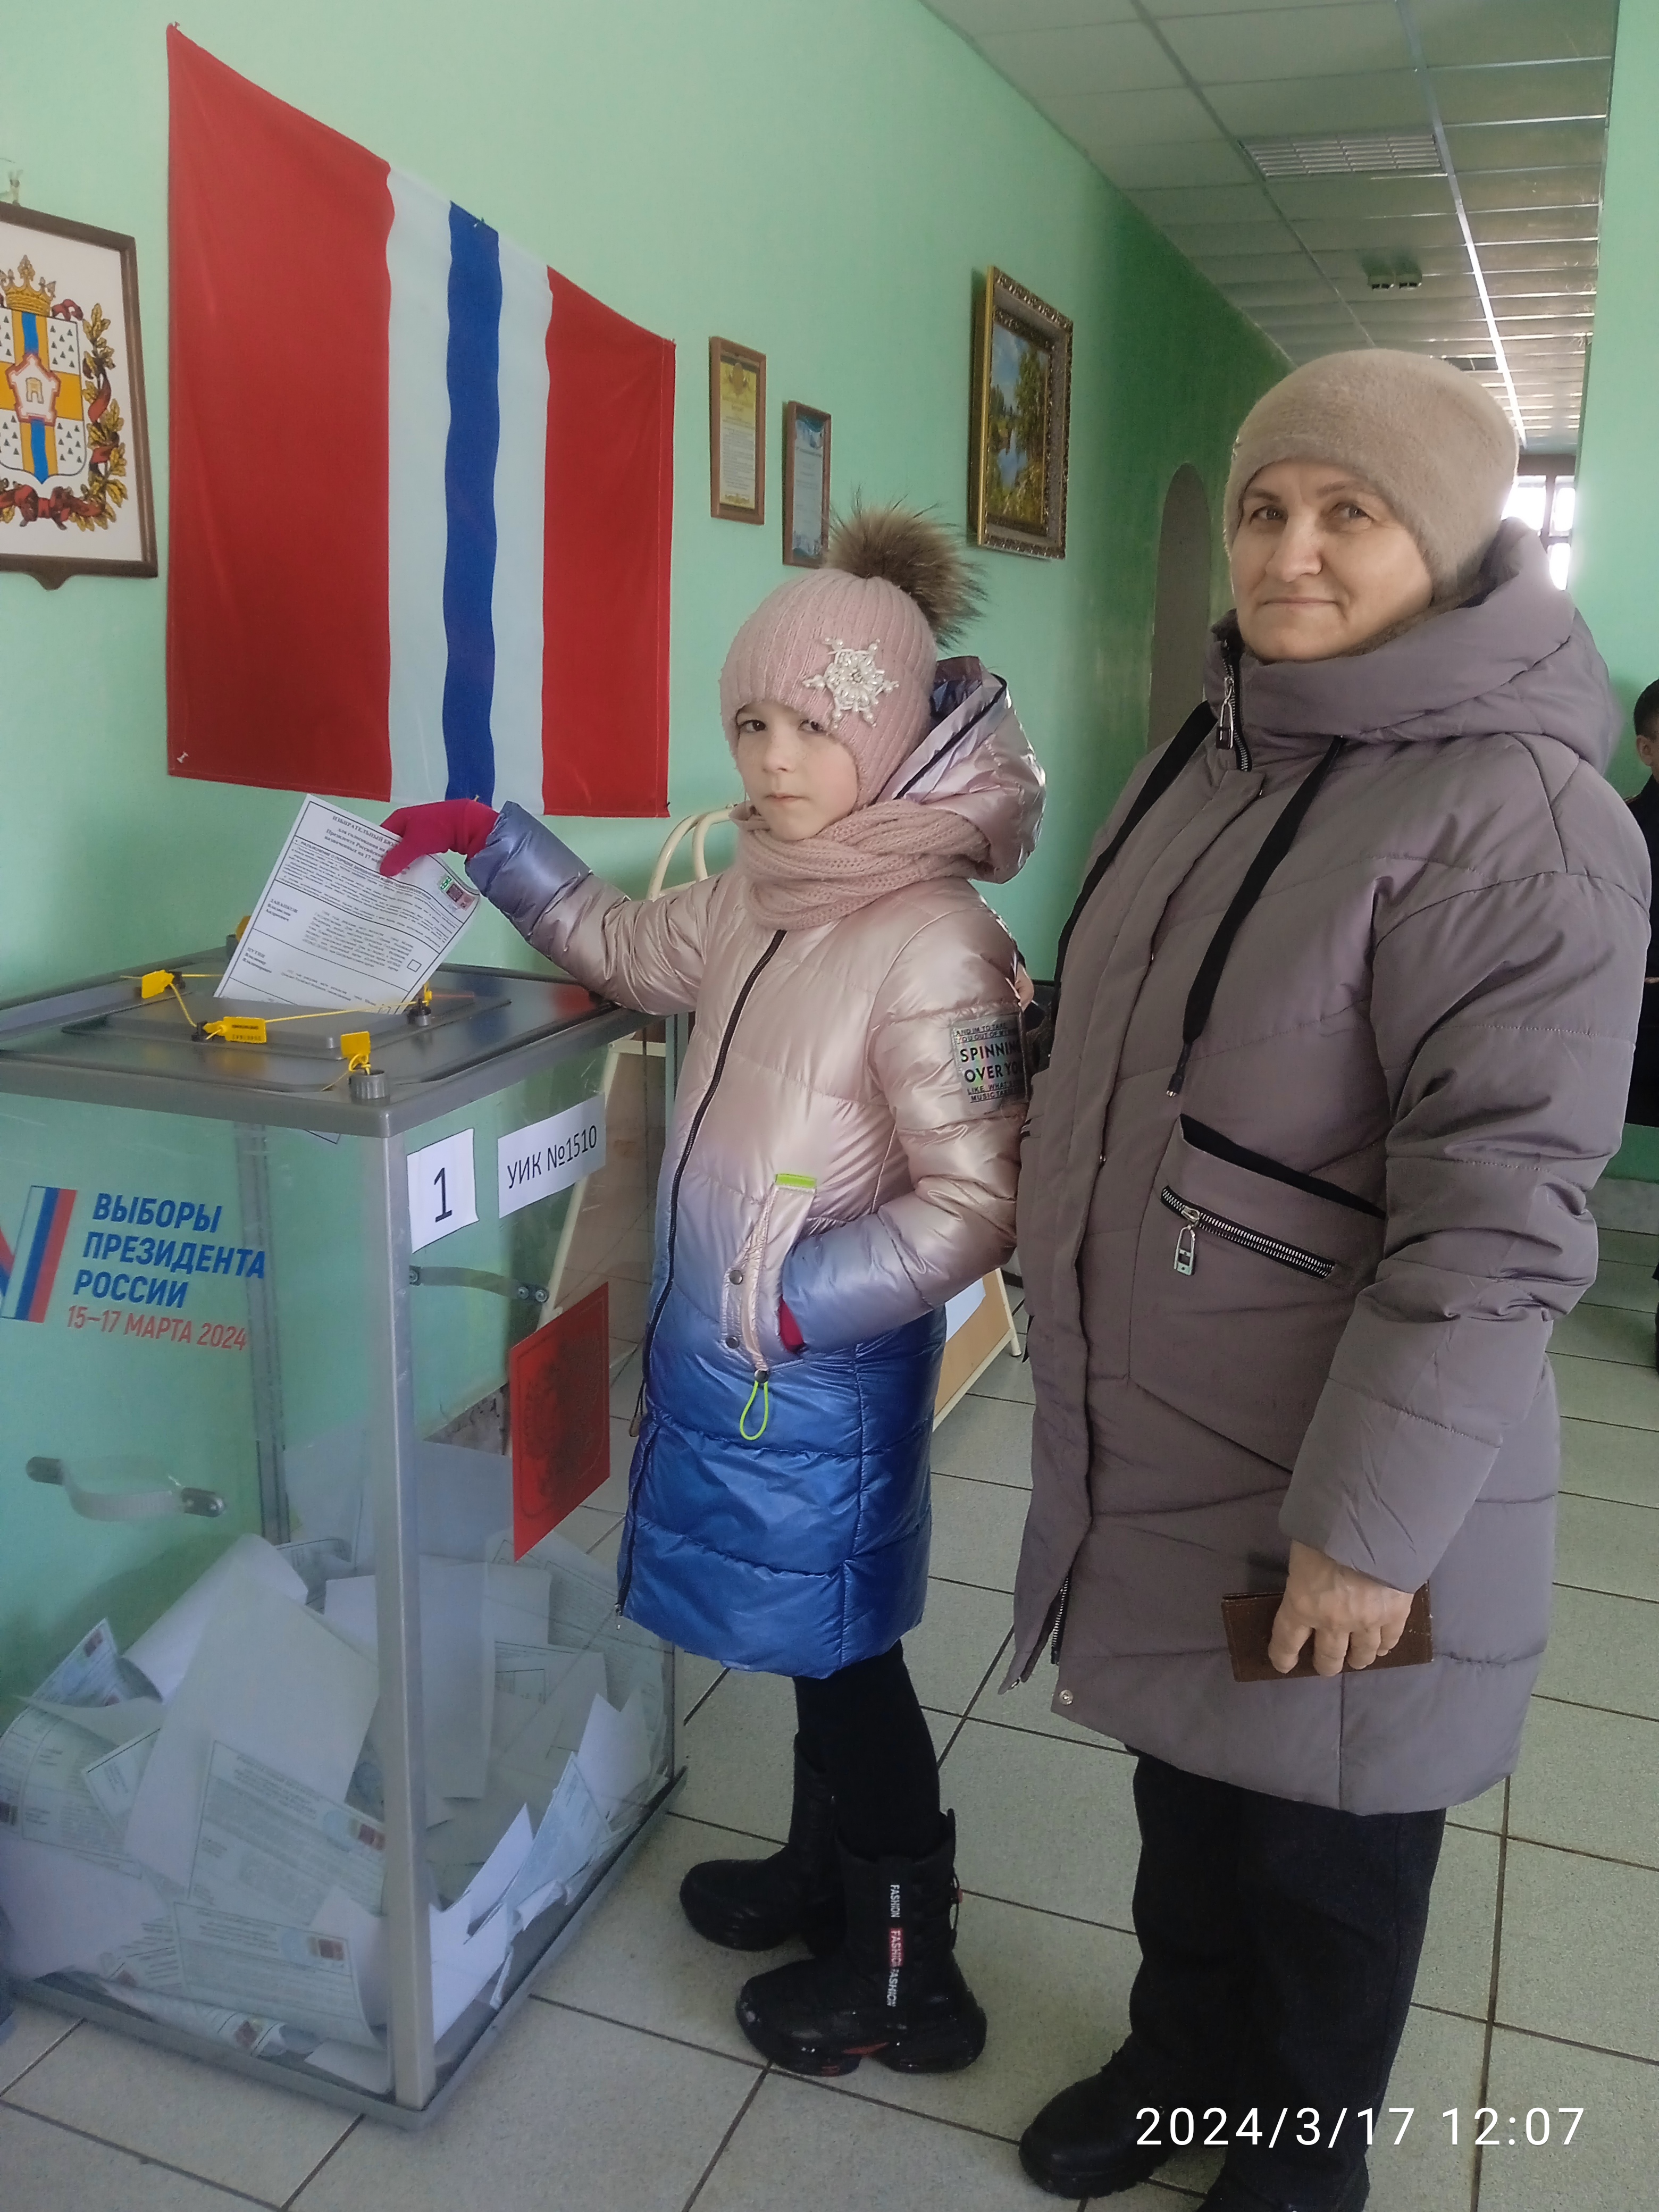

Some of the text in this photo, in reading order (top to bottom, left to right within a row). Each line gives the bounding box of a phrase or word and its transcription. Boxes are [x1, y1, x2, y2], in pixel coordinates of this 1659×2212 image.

[960, 1040, 1022, 1062] SPINNIN
[964, 1060, 1023, 1083] OVER YO
[507, 1125, 597, 1189] УИК №1510
[93, 1193, 222, 1234] ВЫБОРЫ
[434, 1168, 452, 1222] 1
[82, 1231, 265, 1279] ПРЕЗИДЕНТА
[73, 1269, 188, 1309] РОССИИ
[123, 1312, 192, 1344] МАРТА
[197, 1322, 247, 1351] 2024
[890, 1884, 900, 1918] FASHION
